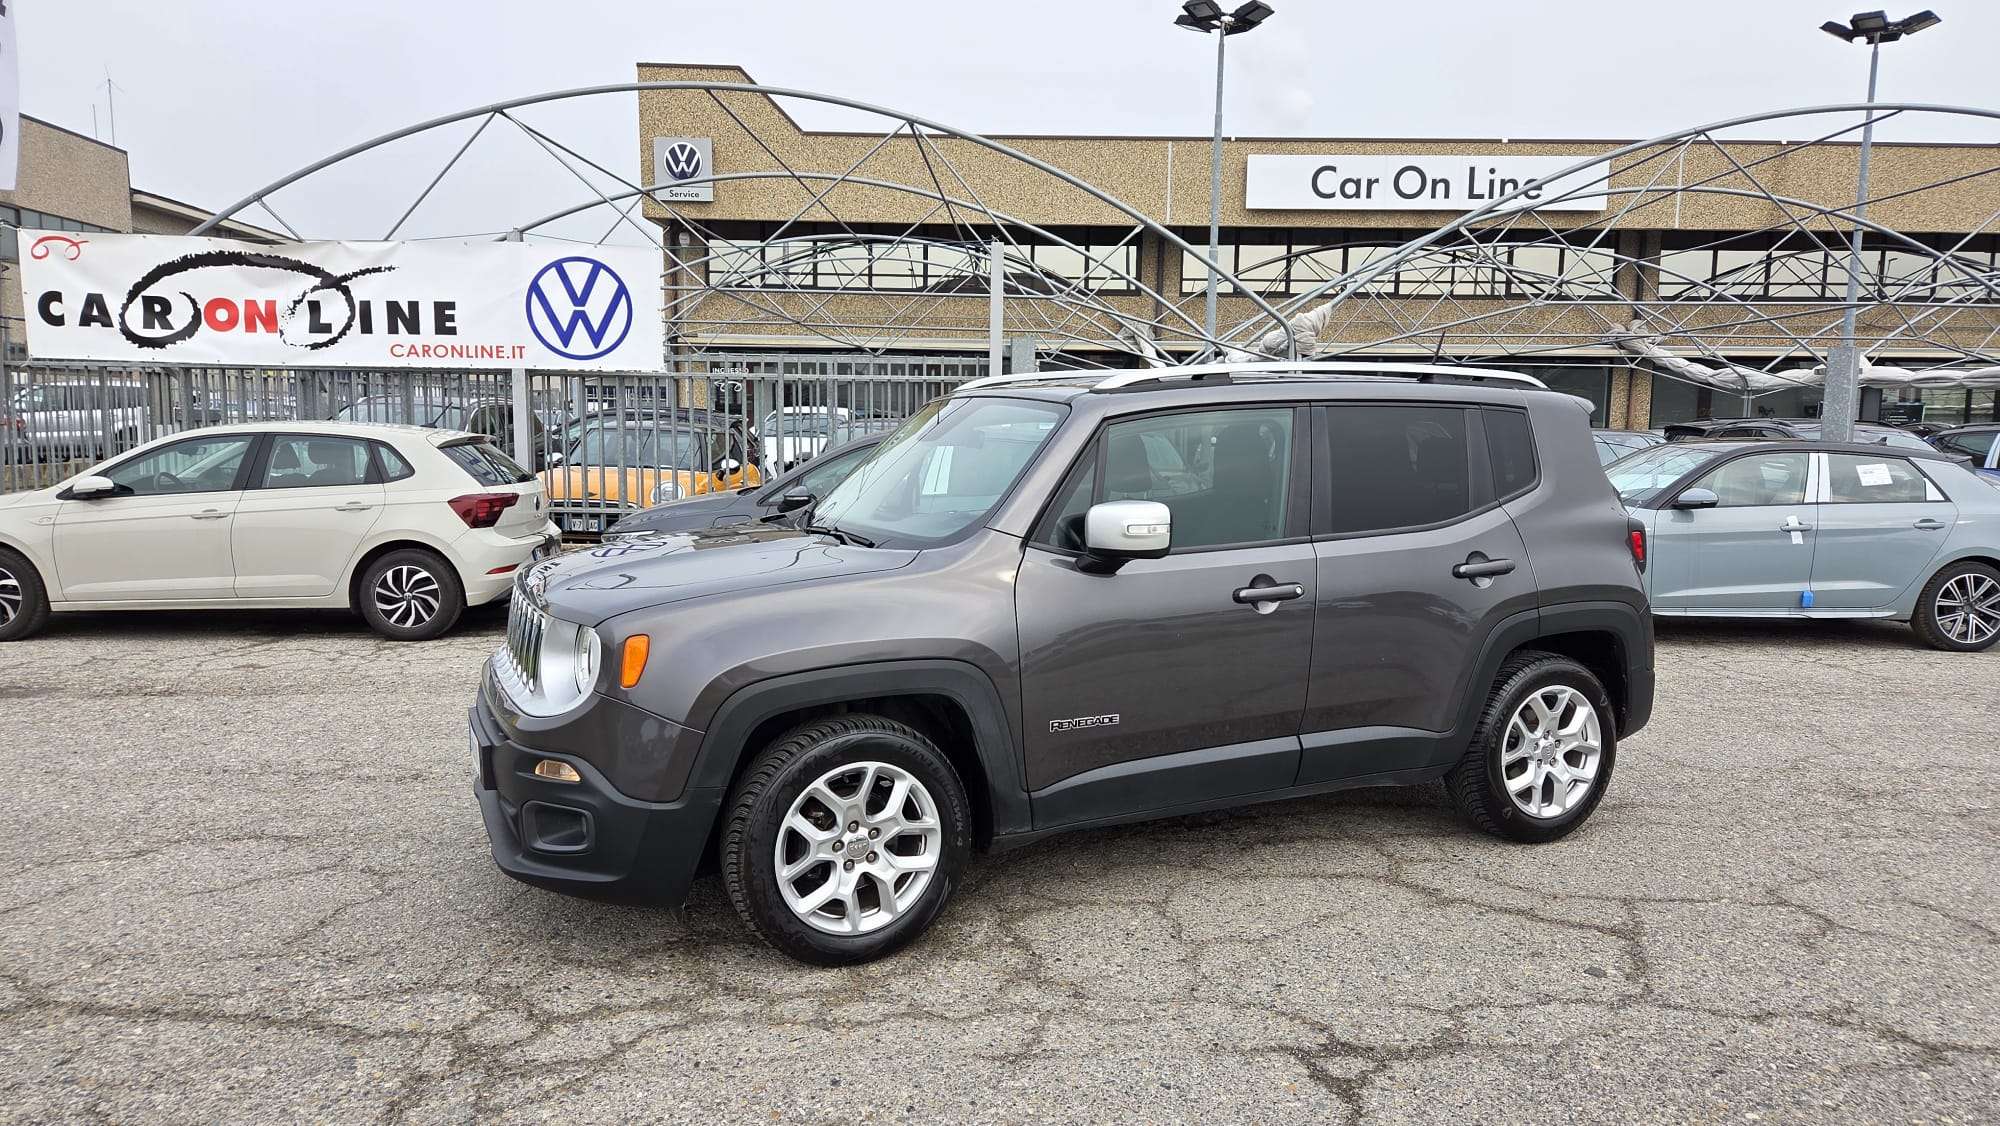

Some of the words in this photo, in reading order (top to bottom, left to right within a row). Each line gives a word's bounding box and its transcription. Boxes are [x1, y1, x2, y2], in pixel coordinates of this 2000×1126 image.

[1311, 165, 1379, 199] Car
[1393, 165, 1450, 199] On
[1467, 166, 1543, 200] Line
[669, 189, 700, 198] Service
[38, 290, 175, 330] CAR
[203, 297, 279, 333] ON
[307, 299, 458, 336] LINE
[390, 343, 526, 360] CARONLINE.IT
[1049, 714, 1120, 732] RENEGADE
